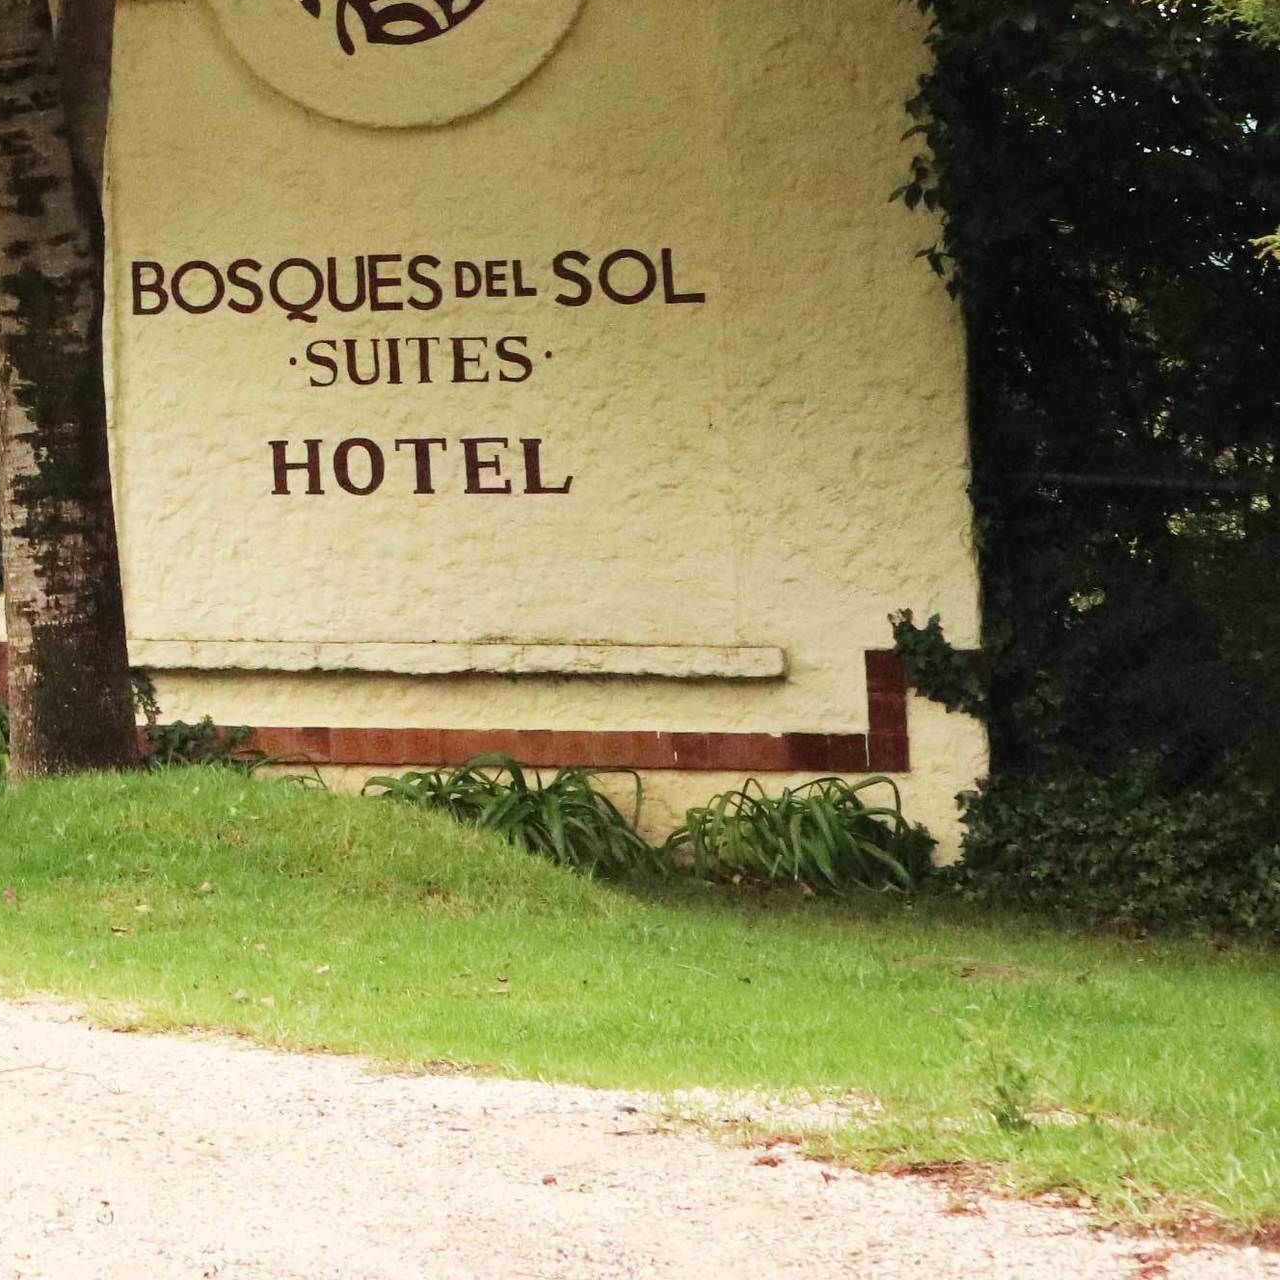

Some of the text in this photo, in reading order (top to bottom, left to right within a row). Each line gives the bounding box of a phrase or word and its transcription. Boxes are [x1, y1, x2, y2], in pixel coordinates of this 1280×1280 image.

[131, 247, 707, 324] BOSQUES DEL SOL
[267, 437, 574, 496] HOTEL
